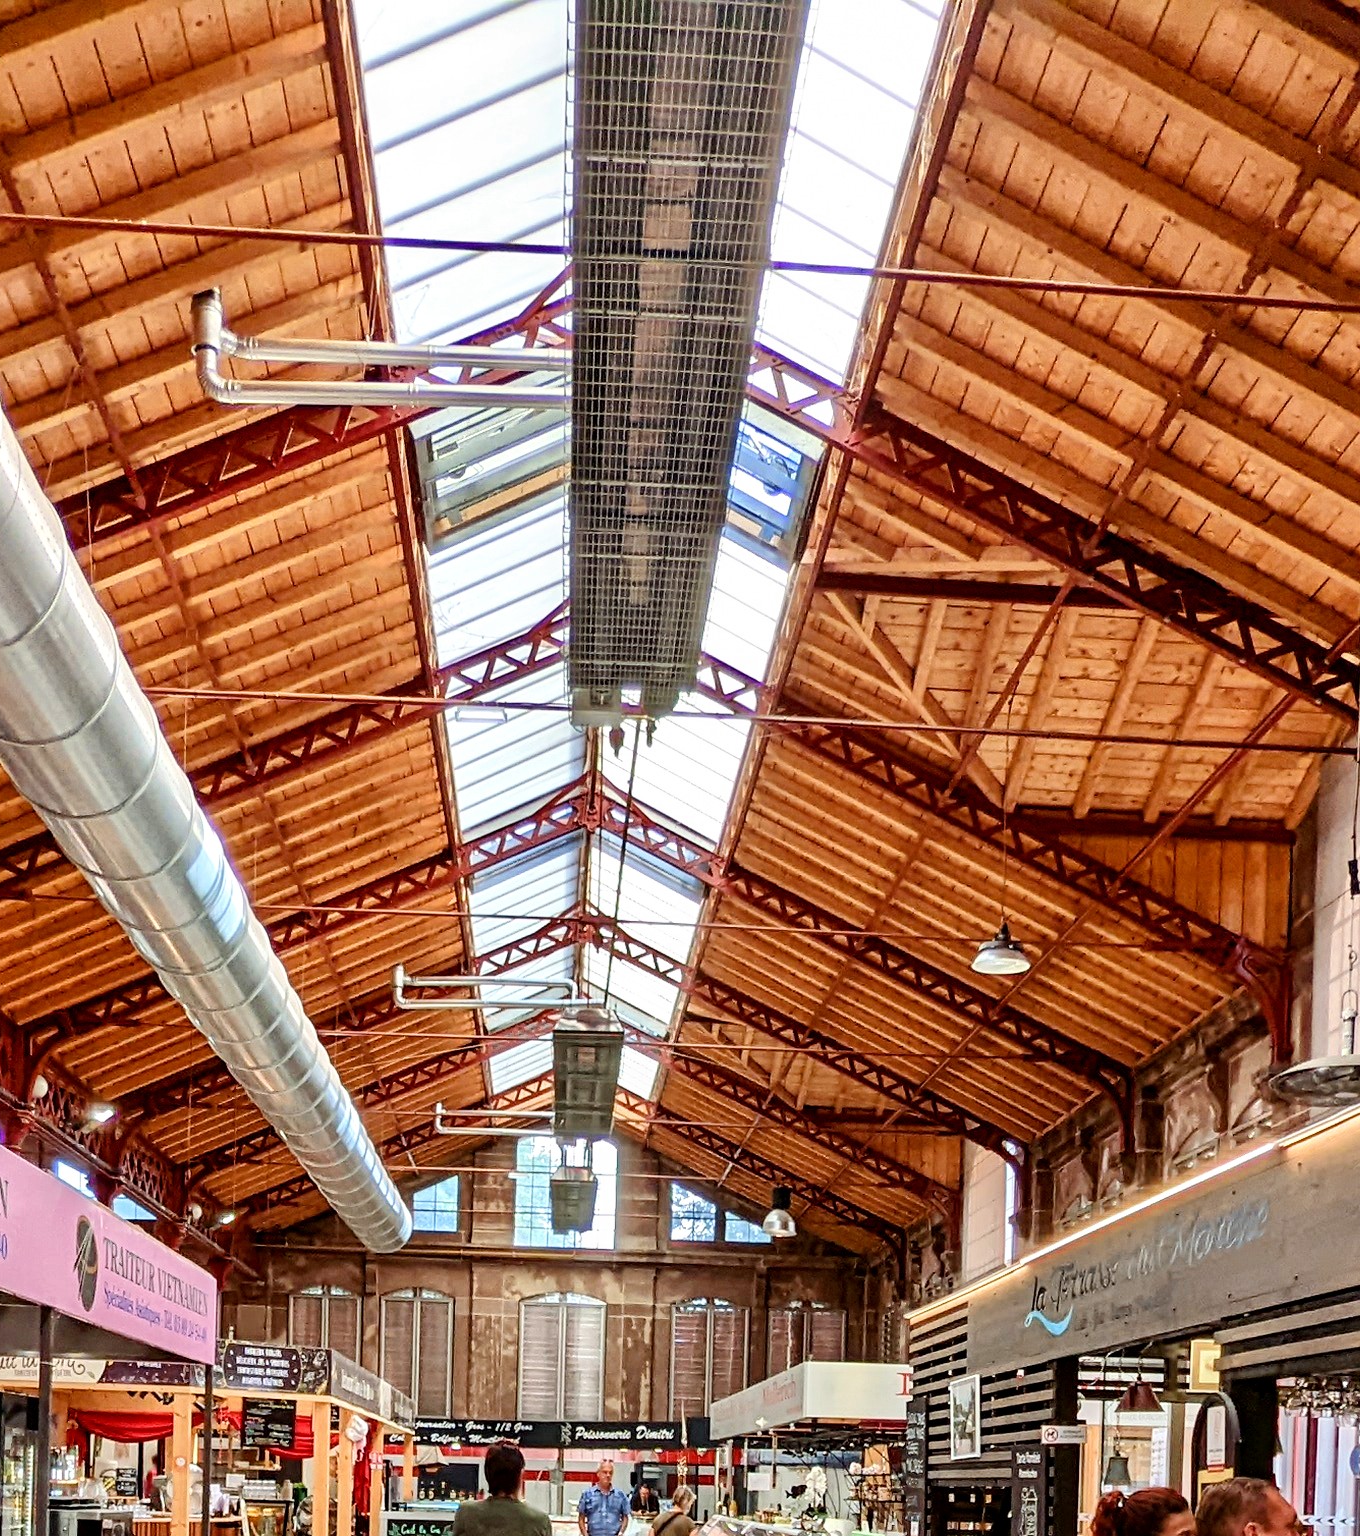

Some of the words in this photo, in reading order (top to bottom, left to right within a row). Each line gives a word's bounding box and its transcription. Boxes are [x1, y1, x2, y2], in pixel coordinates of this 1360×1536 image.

[103, 1236, 156, 1293] TRAITEUR
[574, 1425, 632, 1441] Poissonnerie
[634, 1424, 675, 1440] Dimitri
